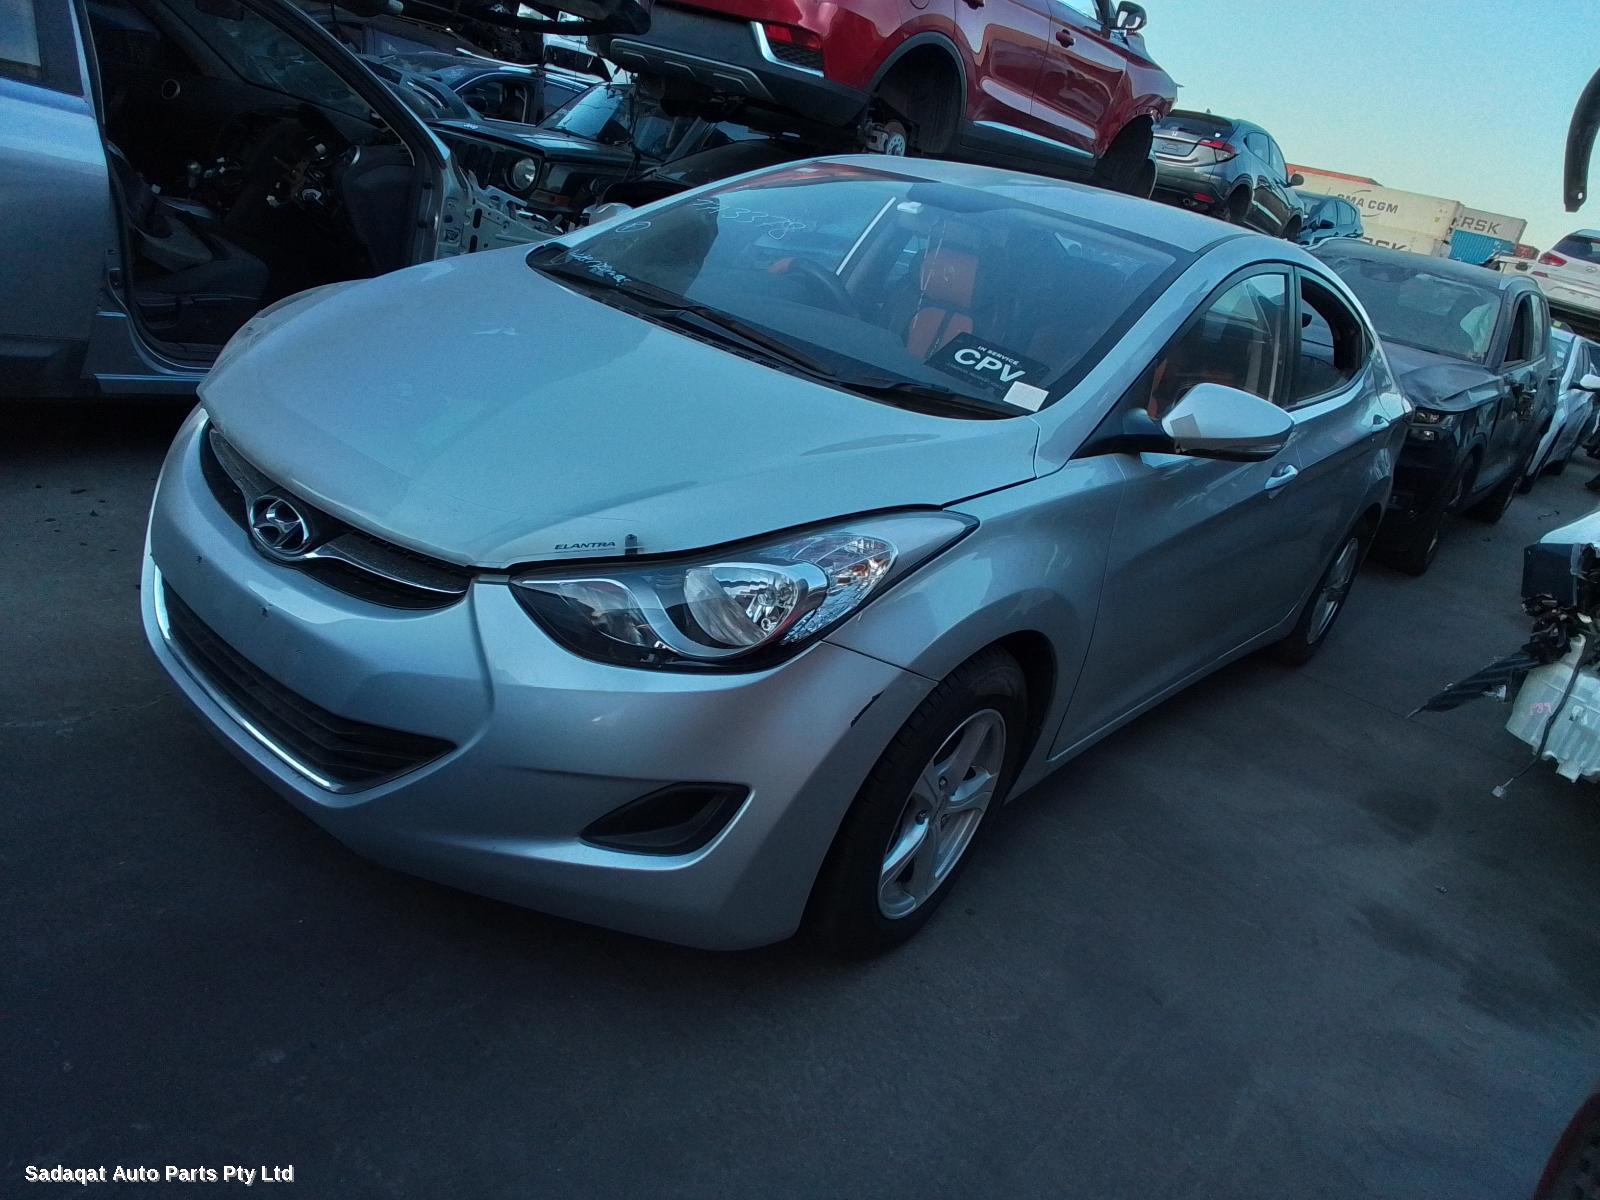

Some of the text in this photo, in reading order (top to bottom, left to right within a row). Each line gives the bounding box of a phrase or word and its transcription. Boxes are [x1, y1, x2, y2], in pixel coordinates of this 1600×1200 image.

[1368, 199, 1399, 214] CGM
[954, 348, 1026, 382] CPV
[987, 350, 1020, 365] SERVICE
[554, 541, 616, 550] ELANTRA
